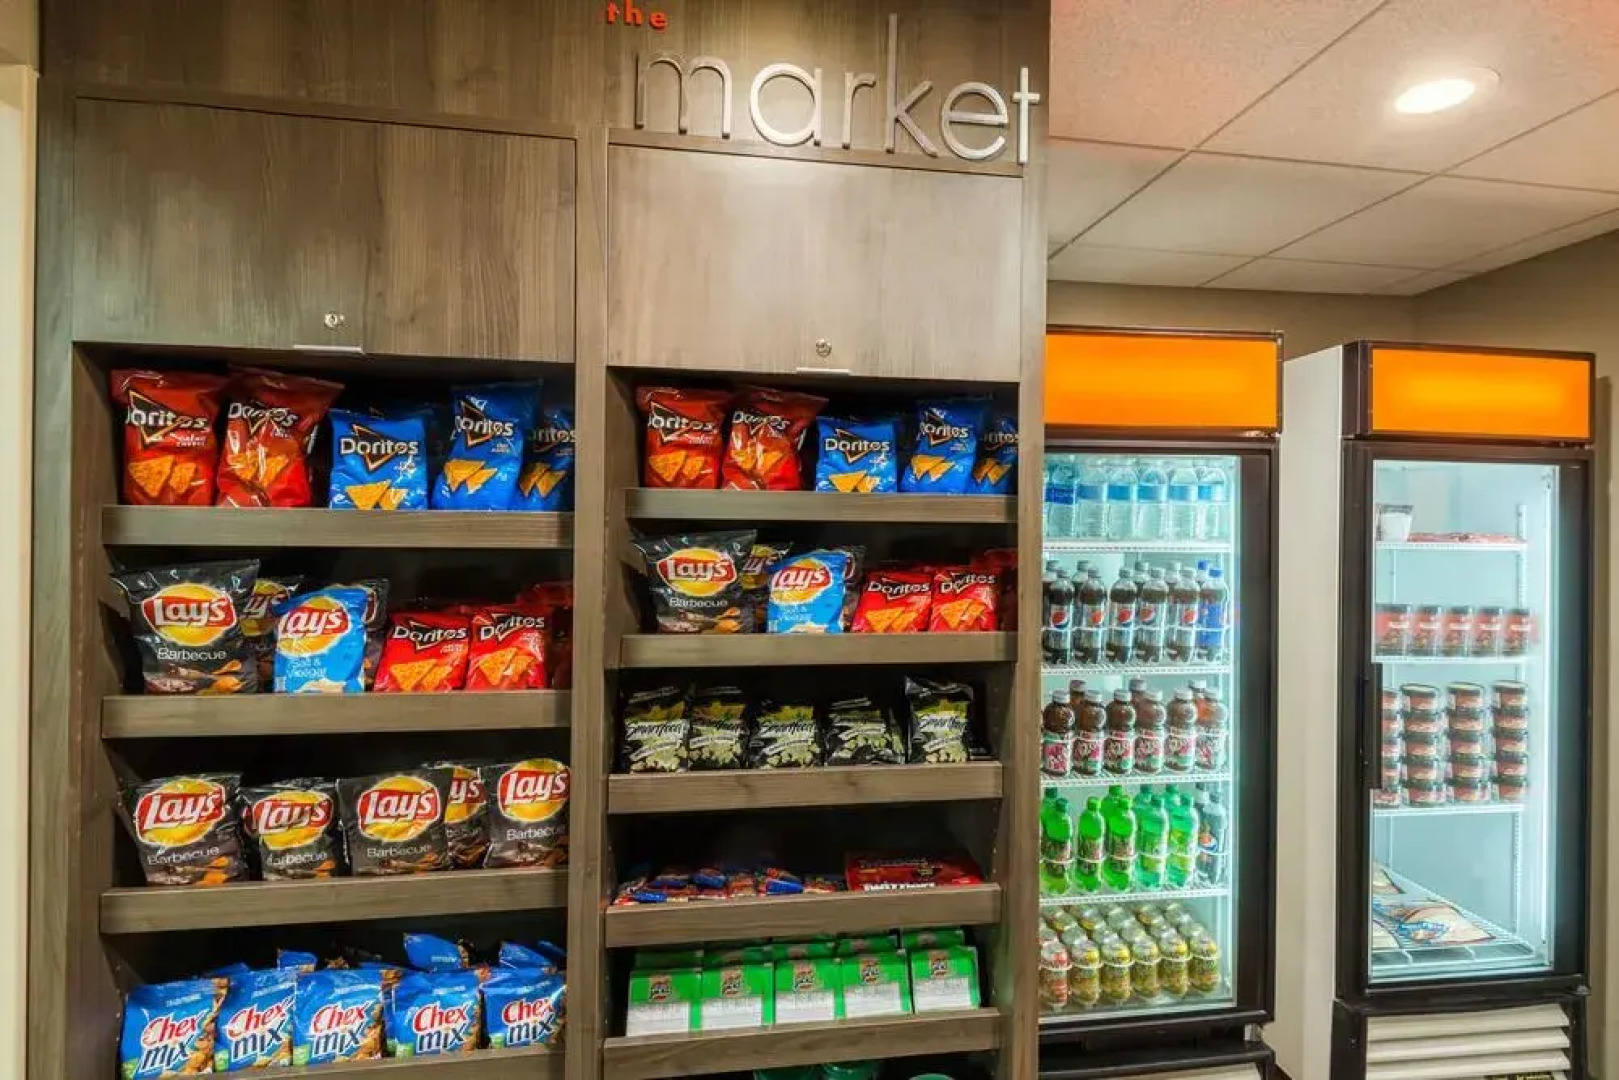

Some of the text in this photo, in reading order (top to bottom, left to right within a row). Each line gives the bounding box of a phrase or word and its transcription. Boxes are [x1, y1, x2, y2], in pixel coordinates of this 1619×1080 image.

[606, 0, 668, 29] the
[634, 13, 1040, 164] market
[340, 438, 418, 455] Doritos
[825, 438, 890, 451] Doritos
[868, 581, 930, 596] Doritos
[941, 573, 996, 593] Doritos
[669, 597, 728, 608] Barbecue
[392, 626, 467, 642] Doritos
[480, 615, 545, 640] Doritos
[156, 648, 227, 660] Barbecue
[146, 846, 219, 865] Barbecue
[228, 1003, 288, 1038] Chex
[312, 1003, 367, 1035] Chex
[414, 1002, 469, 1032] Chex
[503, 997, 555, 1025] Chex
[142, 1012, 205, 1046] Chex
[232, 1019, 285, 1061] mix
[314, 1021, 365, 1056] mix
[418, 1023, 468, 1053] mix
[508, 1018, 556, 1046] mix
[141, 1035, 194, 1071] mix
